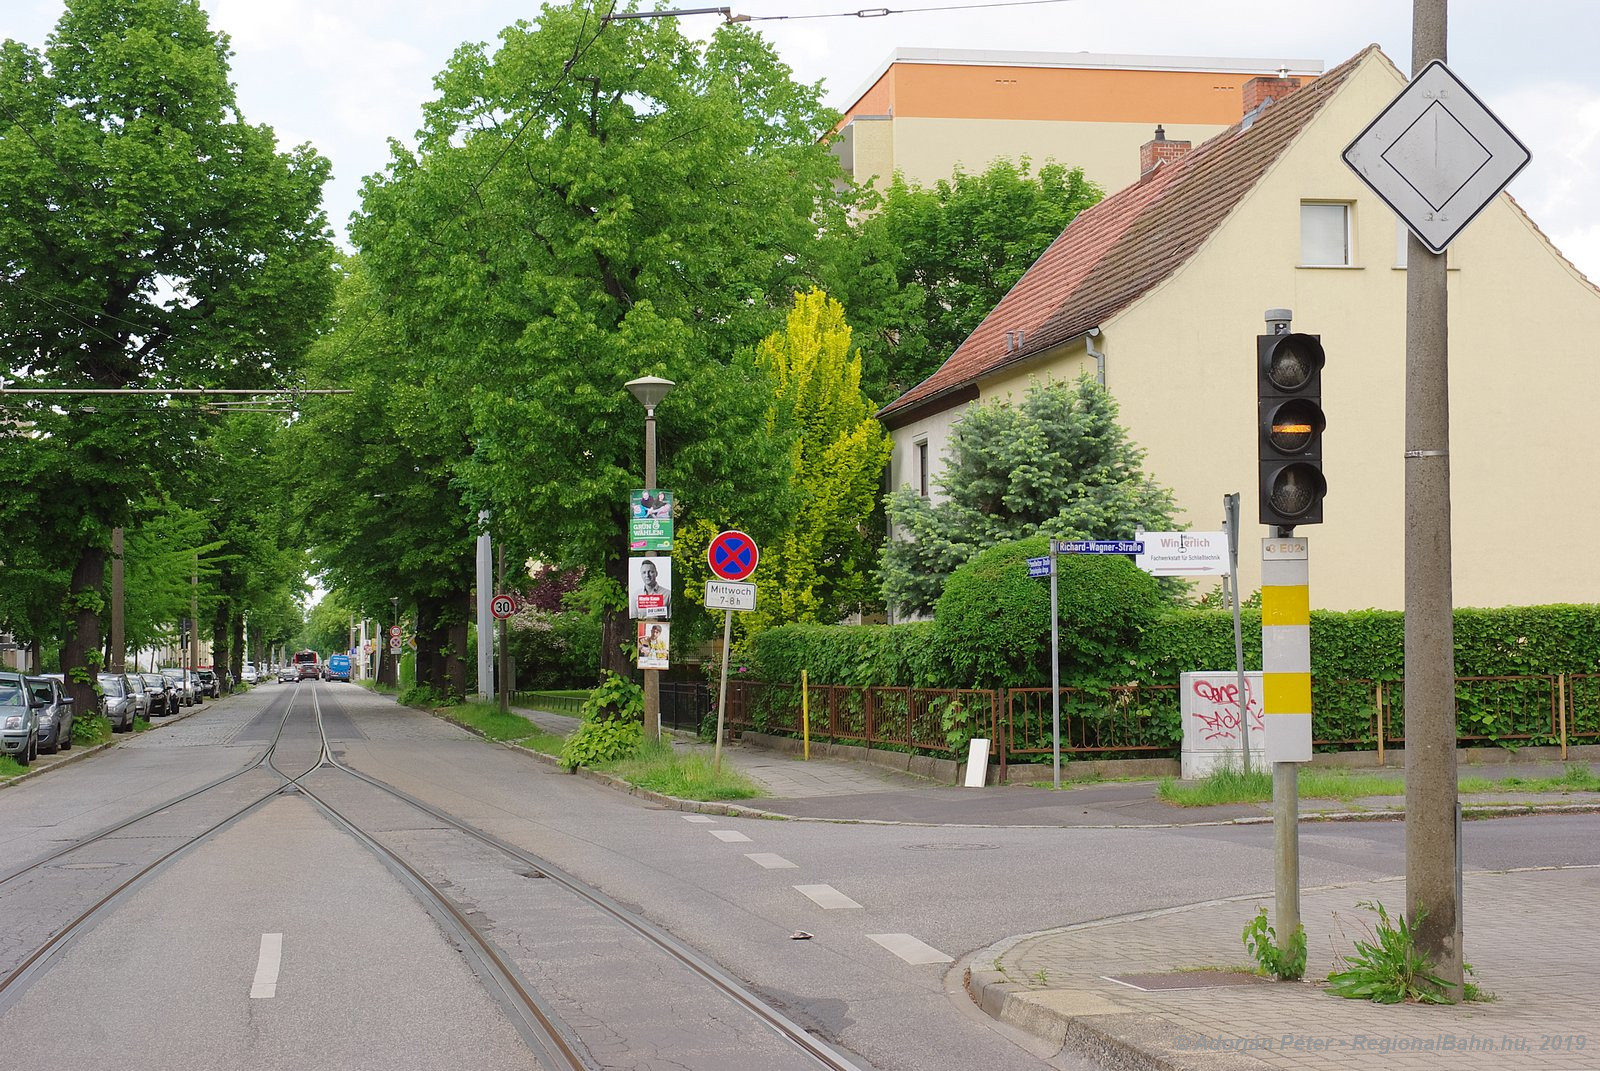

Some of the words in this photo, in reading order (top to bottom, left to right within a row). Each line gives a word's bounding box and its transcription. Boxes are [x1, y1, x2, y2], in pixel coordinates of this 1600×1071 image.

[1059, 542, 1142, 553] Richard-Wagner-Straße
[711, 585, 751, 596] Mittwoch
[720, 596, 735, 605] 7-8
[736, 598, 741, 606] h
[495, 601, 510, 613] 30
